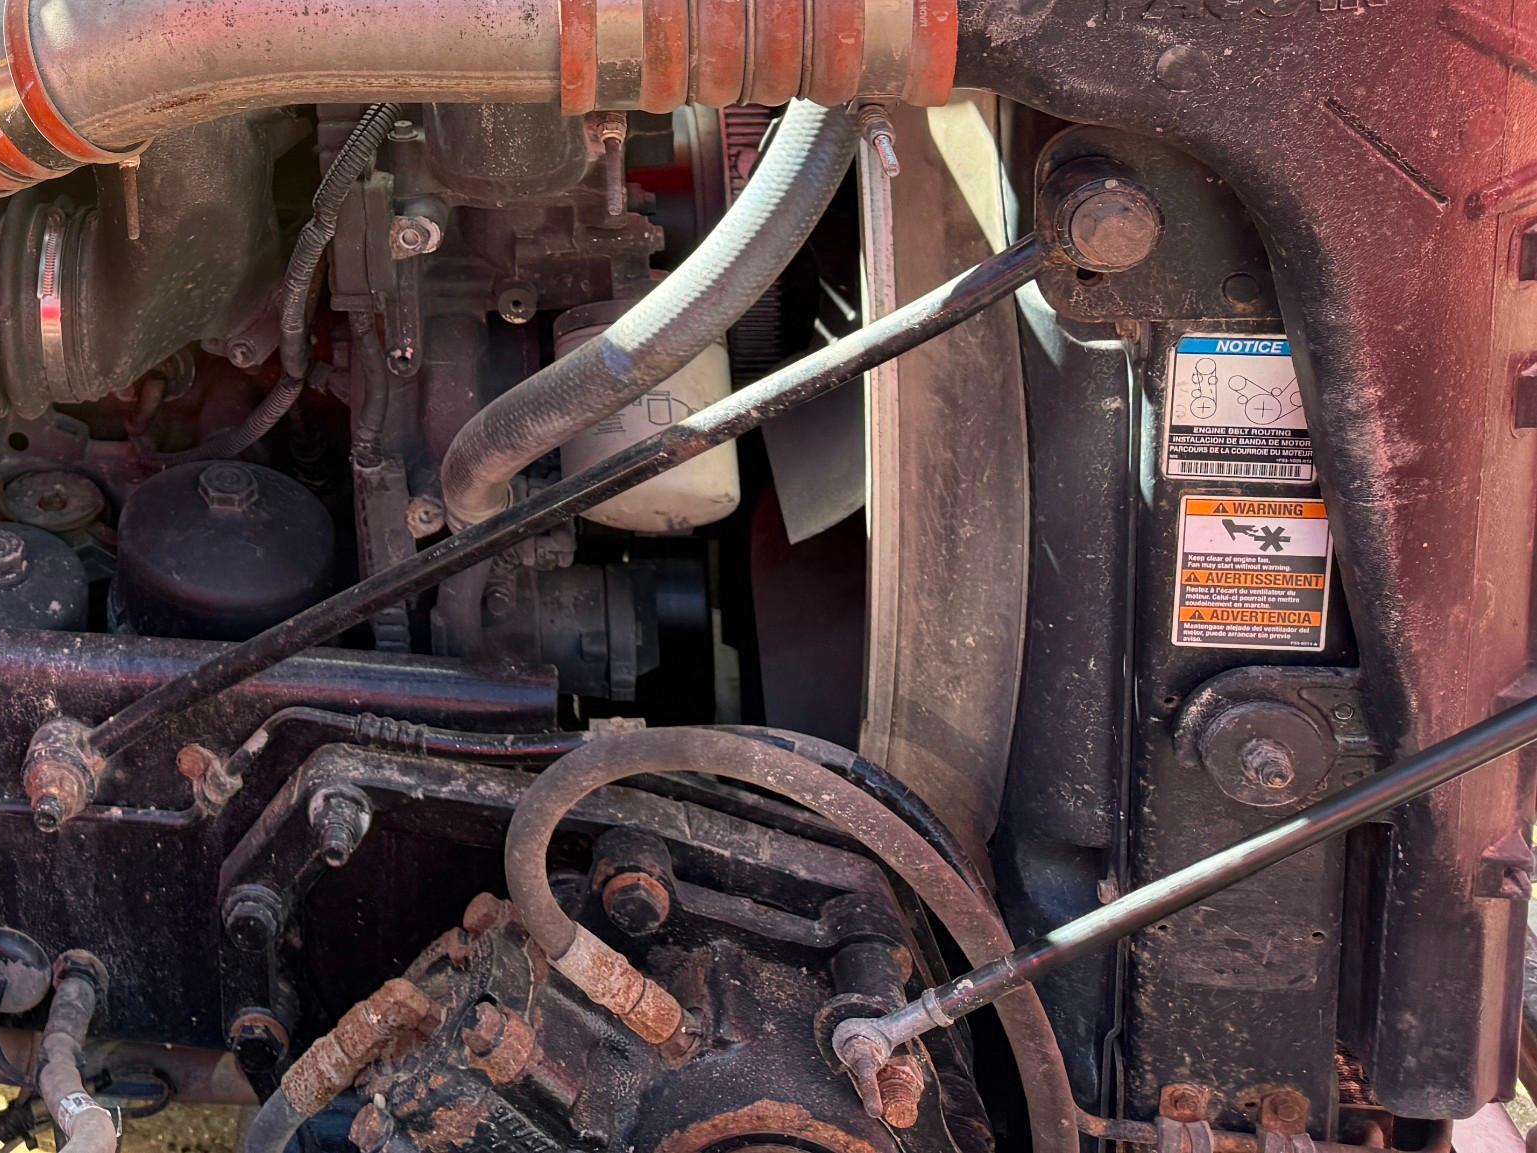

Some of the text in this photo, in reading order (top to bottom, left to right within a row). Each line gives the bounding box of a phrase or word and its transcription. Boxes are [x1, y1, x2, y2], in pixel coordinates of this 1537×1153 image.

[1216, 340, 1284, 353] NOTICE
[1251, 428, 1292, 436] ROUTING
[1239, 438, 1266, 446] BANDA
[1231, 448, 1268, 456] COURROIE
[1233, 502, 1304, 516] WARNING
[1205, 572, 1322, 587] AVERTISSEMENT
[1239, 595, 1266, 603] pourrait
[1210, 610, 1312, 624] ADVERTENCIA
[1226, 624, 1250, 632] alejado
[1205, 630, 1226, 638] puede
